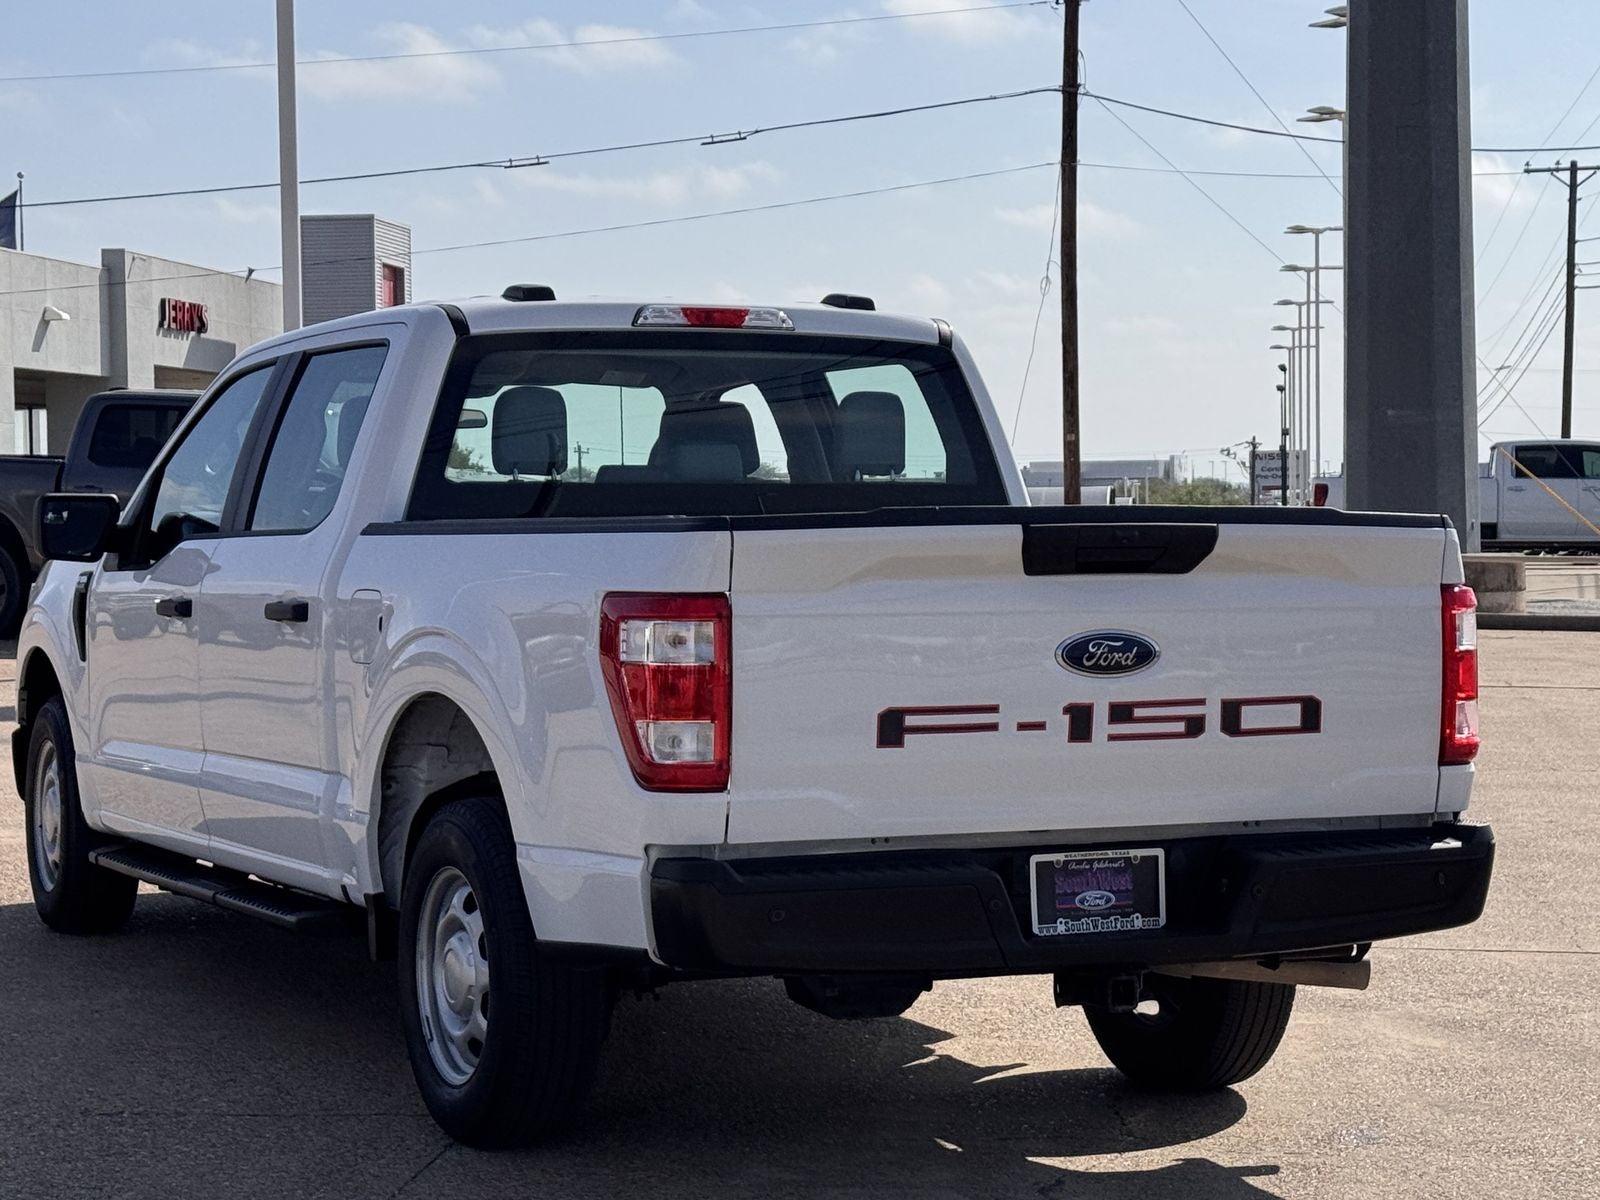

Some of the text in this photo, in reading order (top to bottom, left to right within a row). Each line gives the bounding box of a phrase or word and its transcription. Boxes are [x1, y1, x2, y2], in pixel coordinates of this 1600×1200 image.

[159, 297, 209, 334] JERRY'S
[1083, 639, 1138, 667] Ford
[876, 694, 1323, 749] F-150
[1055, 869, 1134, 893] SouthWest
[1084, 894, 1107, 906] Ford
